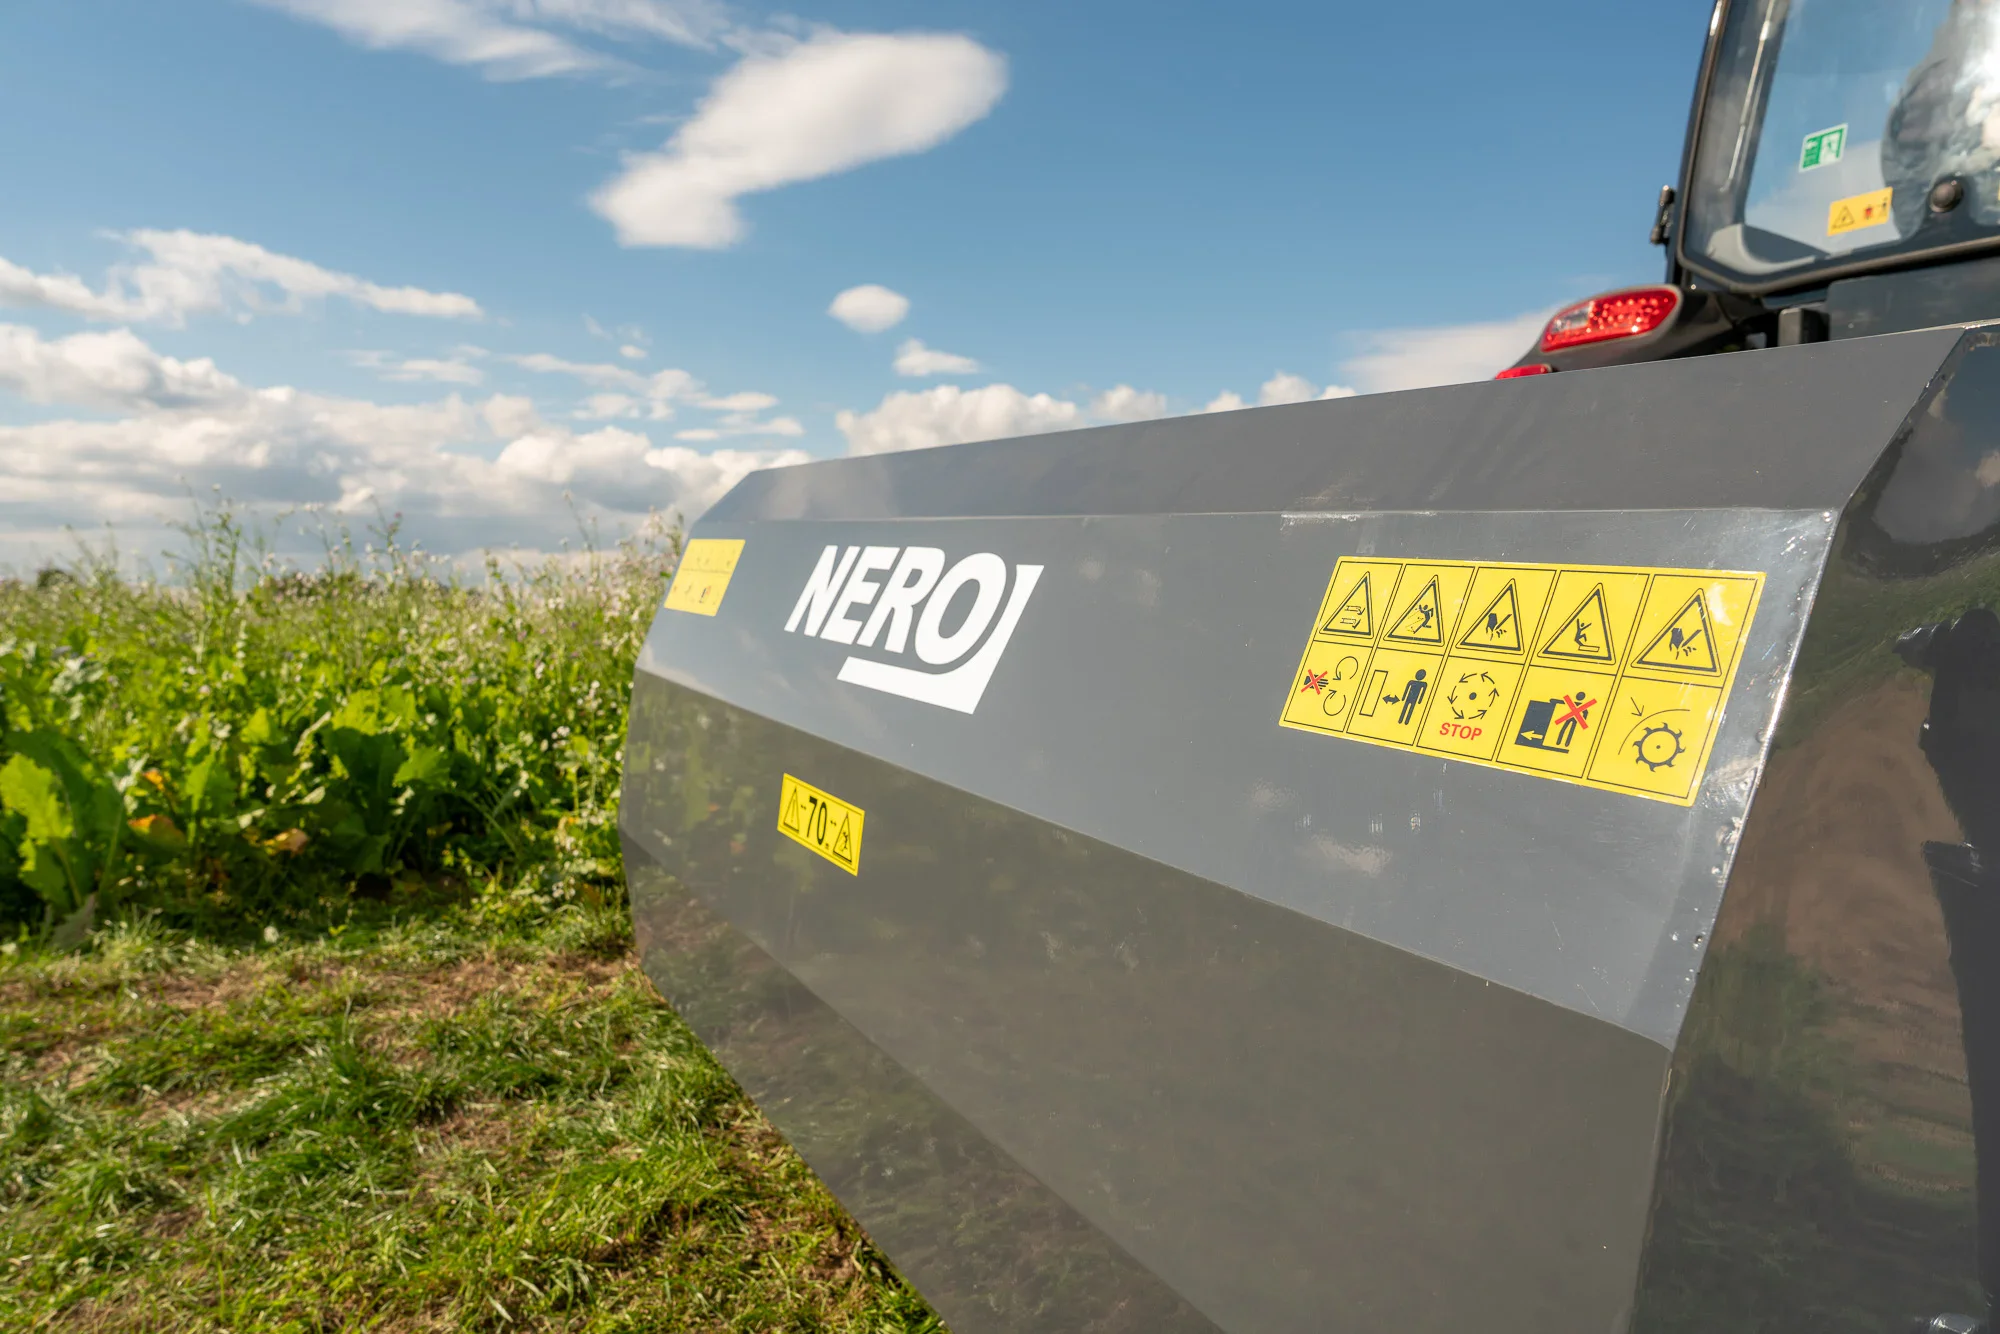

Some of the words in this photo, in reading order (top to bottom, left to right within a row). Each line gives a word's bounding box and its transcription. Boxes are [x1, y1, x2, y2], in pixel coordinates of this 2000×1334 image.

[784, 545, 1007, 665] NERO
[1439, 722, 1482, 741] STOP
[806, 795, 827, 845] 70
